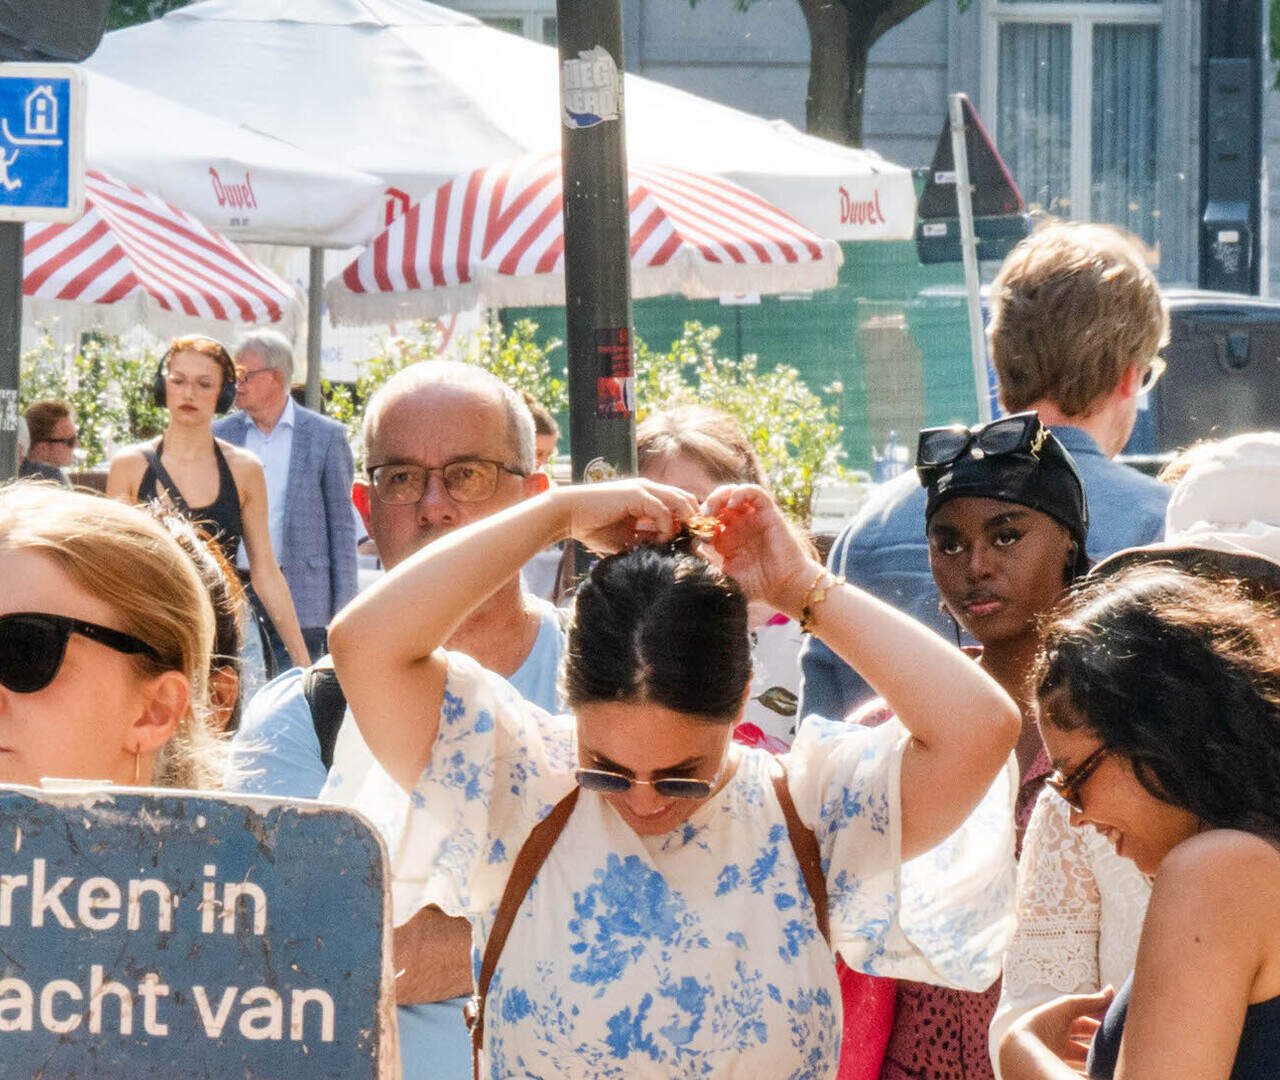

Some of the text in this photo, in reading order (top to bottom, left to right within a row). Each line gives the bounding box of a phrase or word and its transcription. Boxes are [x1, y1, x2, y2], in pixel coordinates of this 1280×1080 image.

[208, 166, 258, 210] Duvel
[839, 185, 886, 225] Duvel
[201, 864, 267, 935] in
[192, 985, 335, 1042] van
